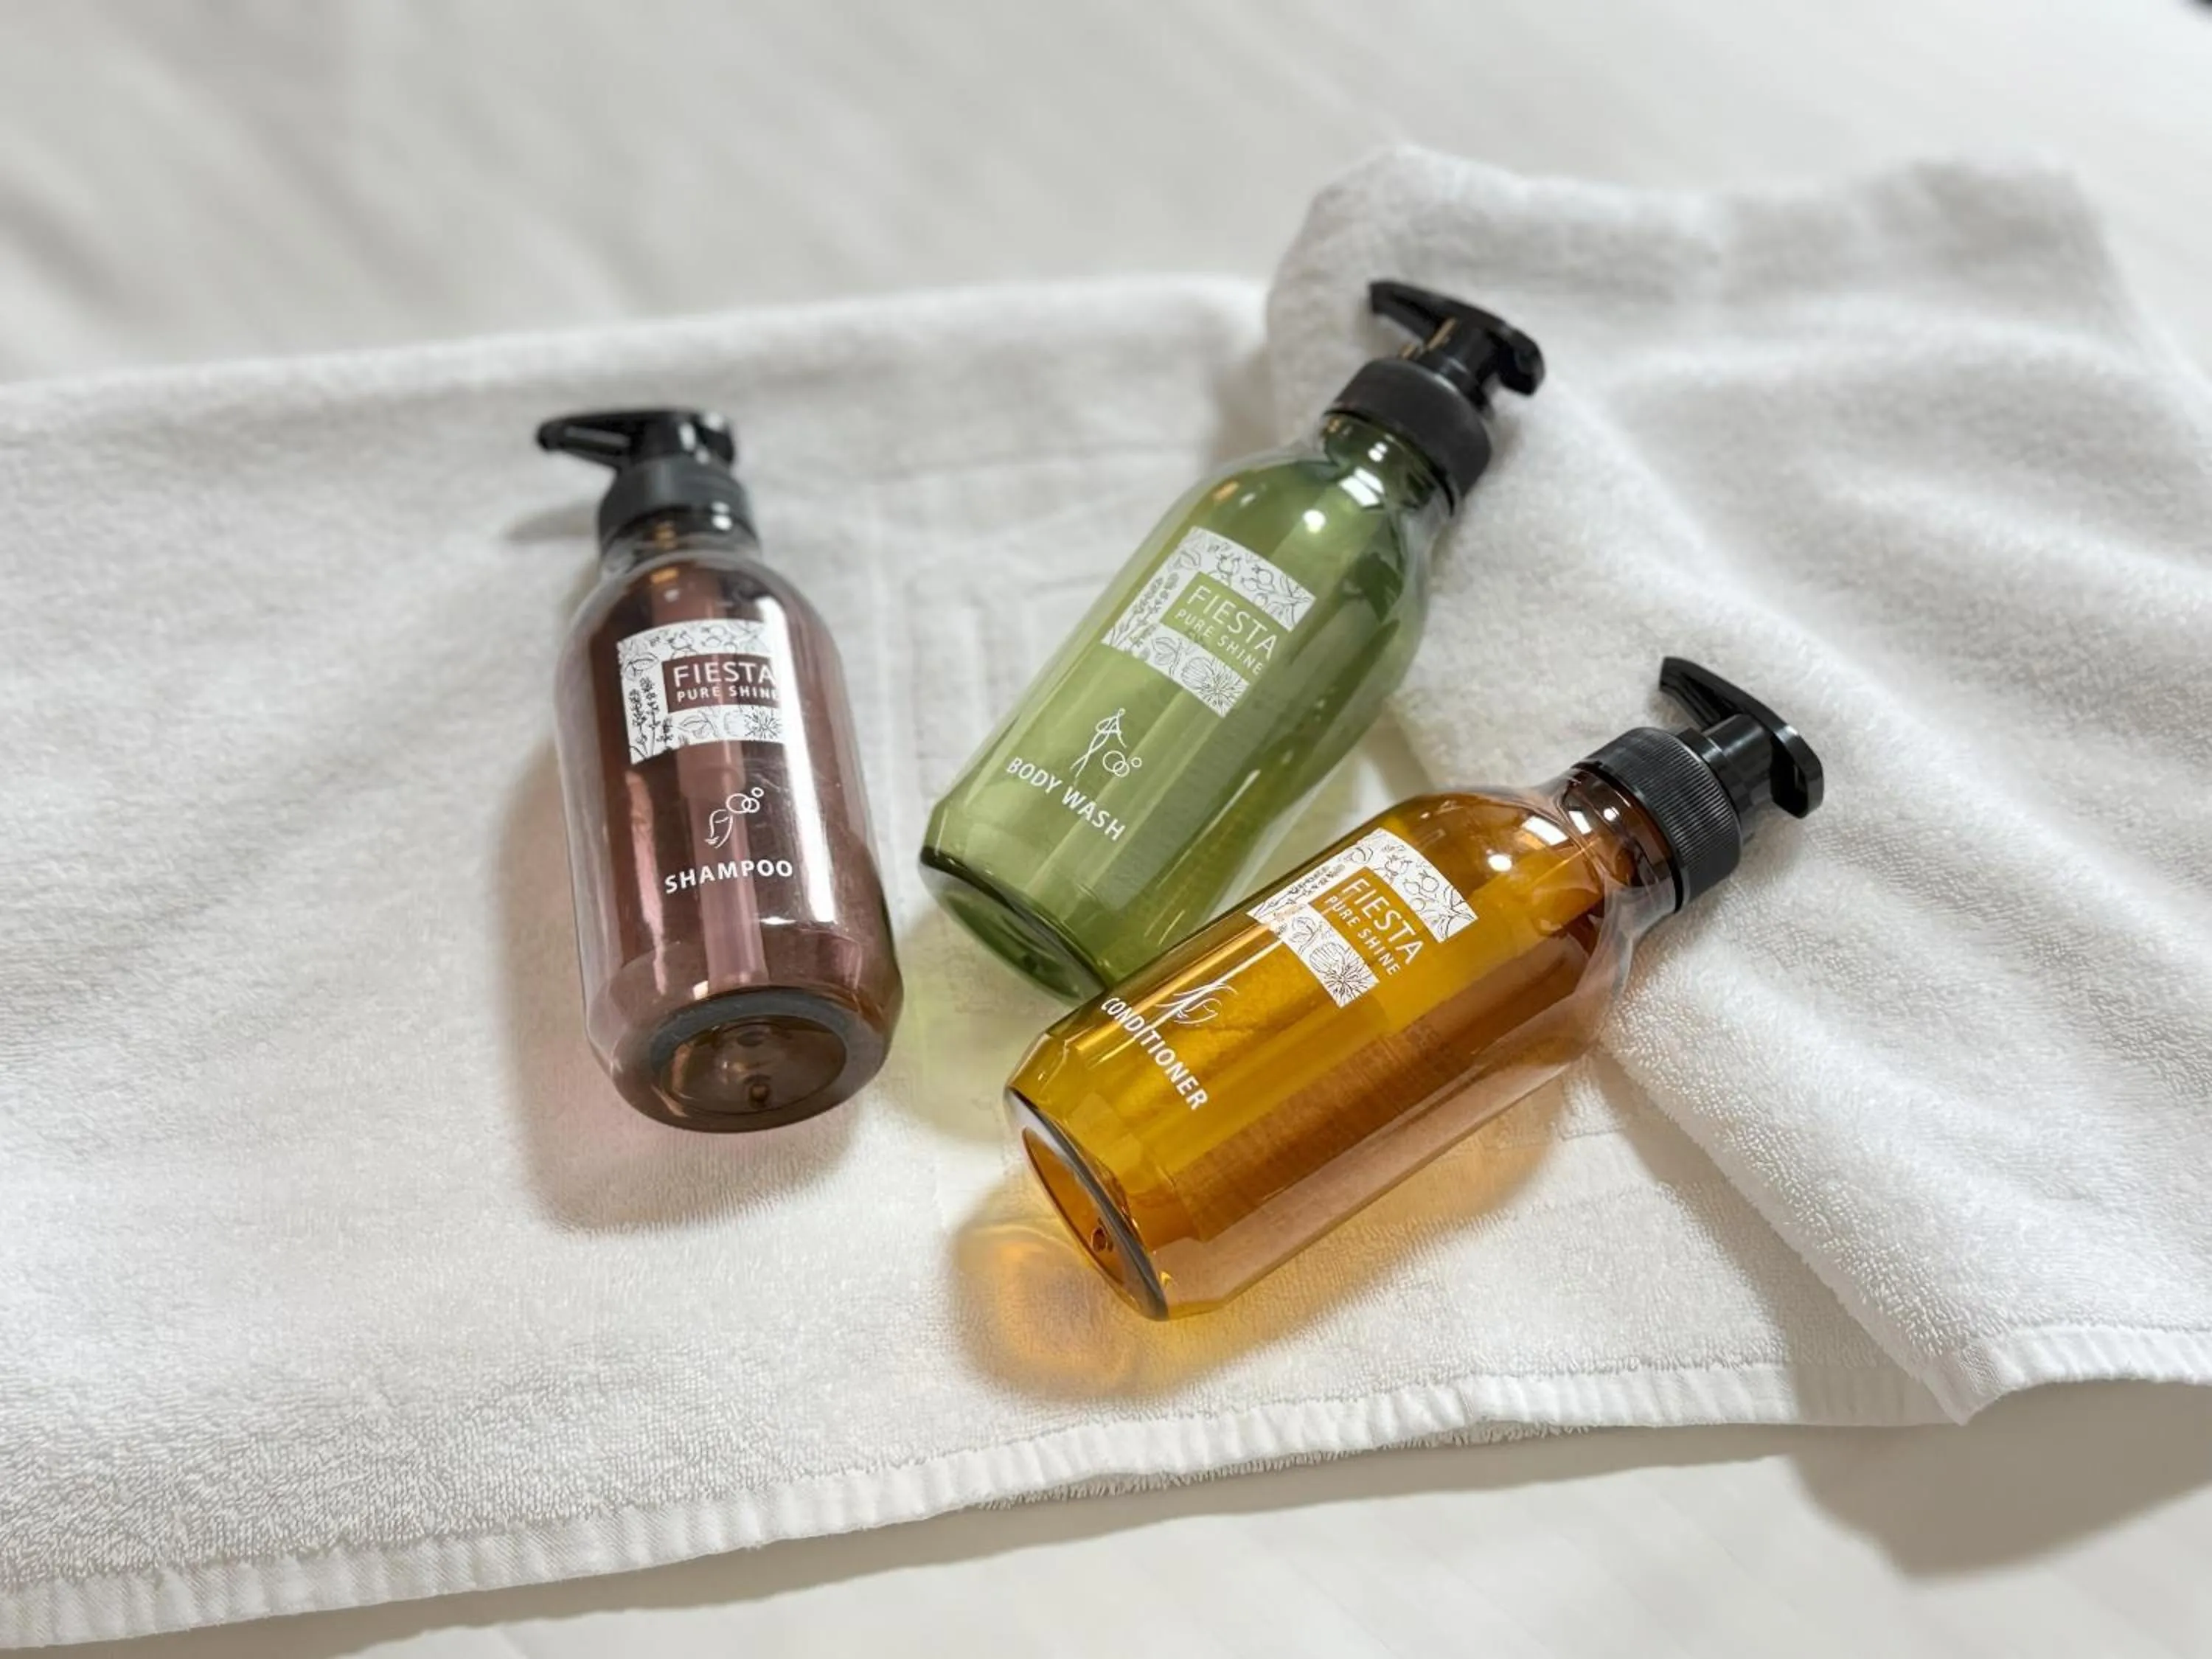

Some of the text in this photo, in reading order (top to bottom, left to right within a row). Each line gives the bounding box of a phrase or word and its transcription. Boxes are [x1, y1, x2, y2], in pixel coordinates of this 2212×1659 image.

[1175, 608, 1263, 675] PURE SHINE
[1186, 585, 1277, 661] FIESTA
[673, 661, 777, 687] FIESTA
[676, 686, 720, 703] PURE
[1006, 757, 1126, 841] BODY WASH
[664, 859, 793, 894] SHAMPOO
[1324, 895, 1401, 975] PURE SHINE
[1342, 877, 1424, 965] FIESTA
[1100, 997, 1208, 1111] CONDITIONER
